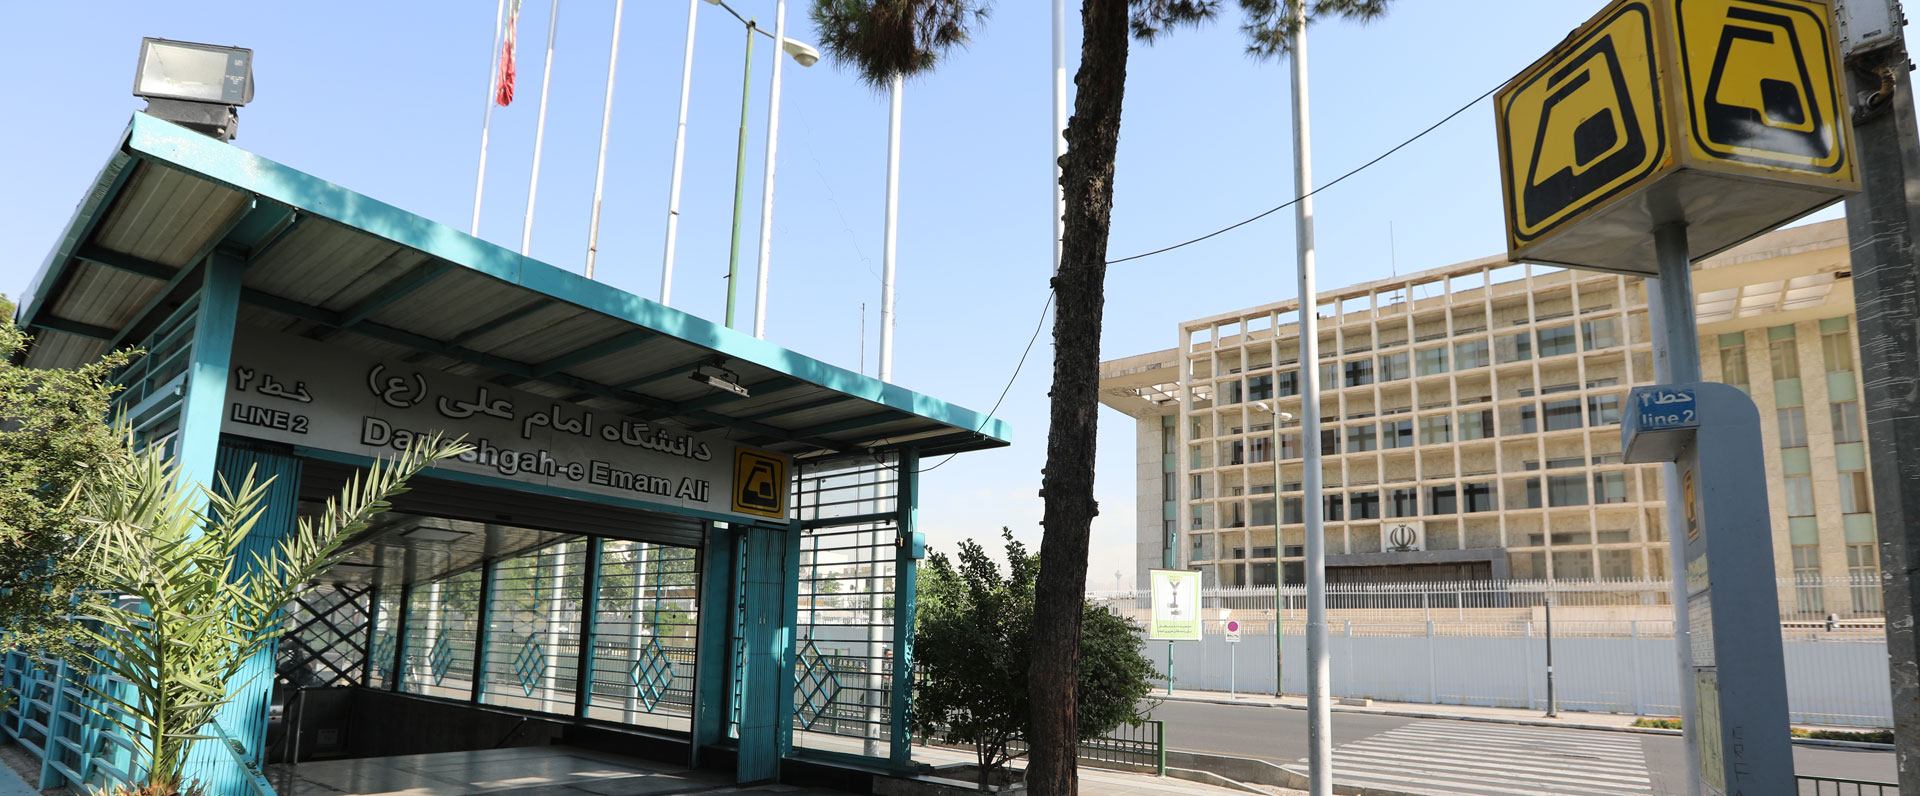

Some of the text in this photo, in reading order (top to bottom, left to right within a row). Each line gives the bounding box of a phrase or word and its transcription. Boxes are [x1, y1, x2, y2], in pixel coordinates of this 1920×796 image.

[236, 365, 313, 404] خط ۲
[231, 402, 309, 434] LINE 2
[368, 364, 713, 461] دانشگاه امام علی (ع)
[1642, 409, 1694, 427] line 2
[588, 459, 672, 496] Emam
[675, 475, 710, 502] Ali
